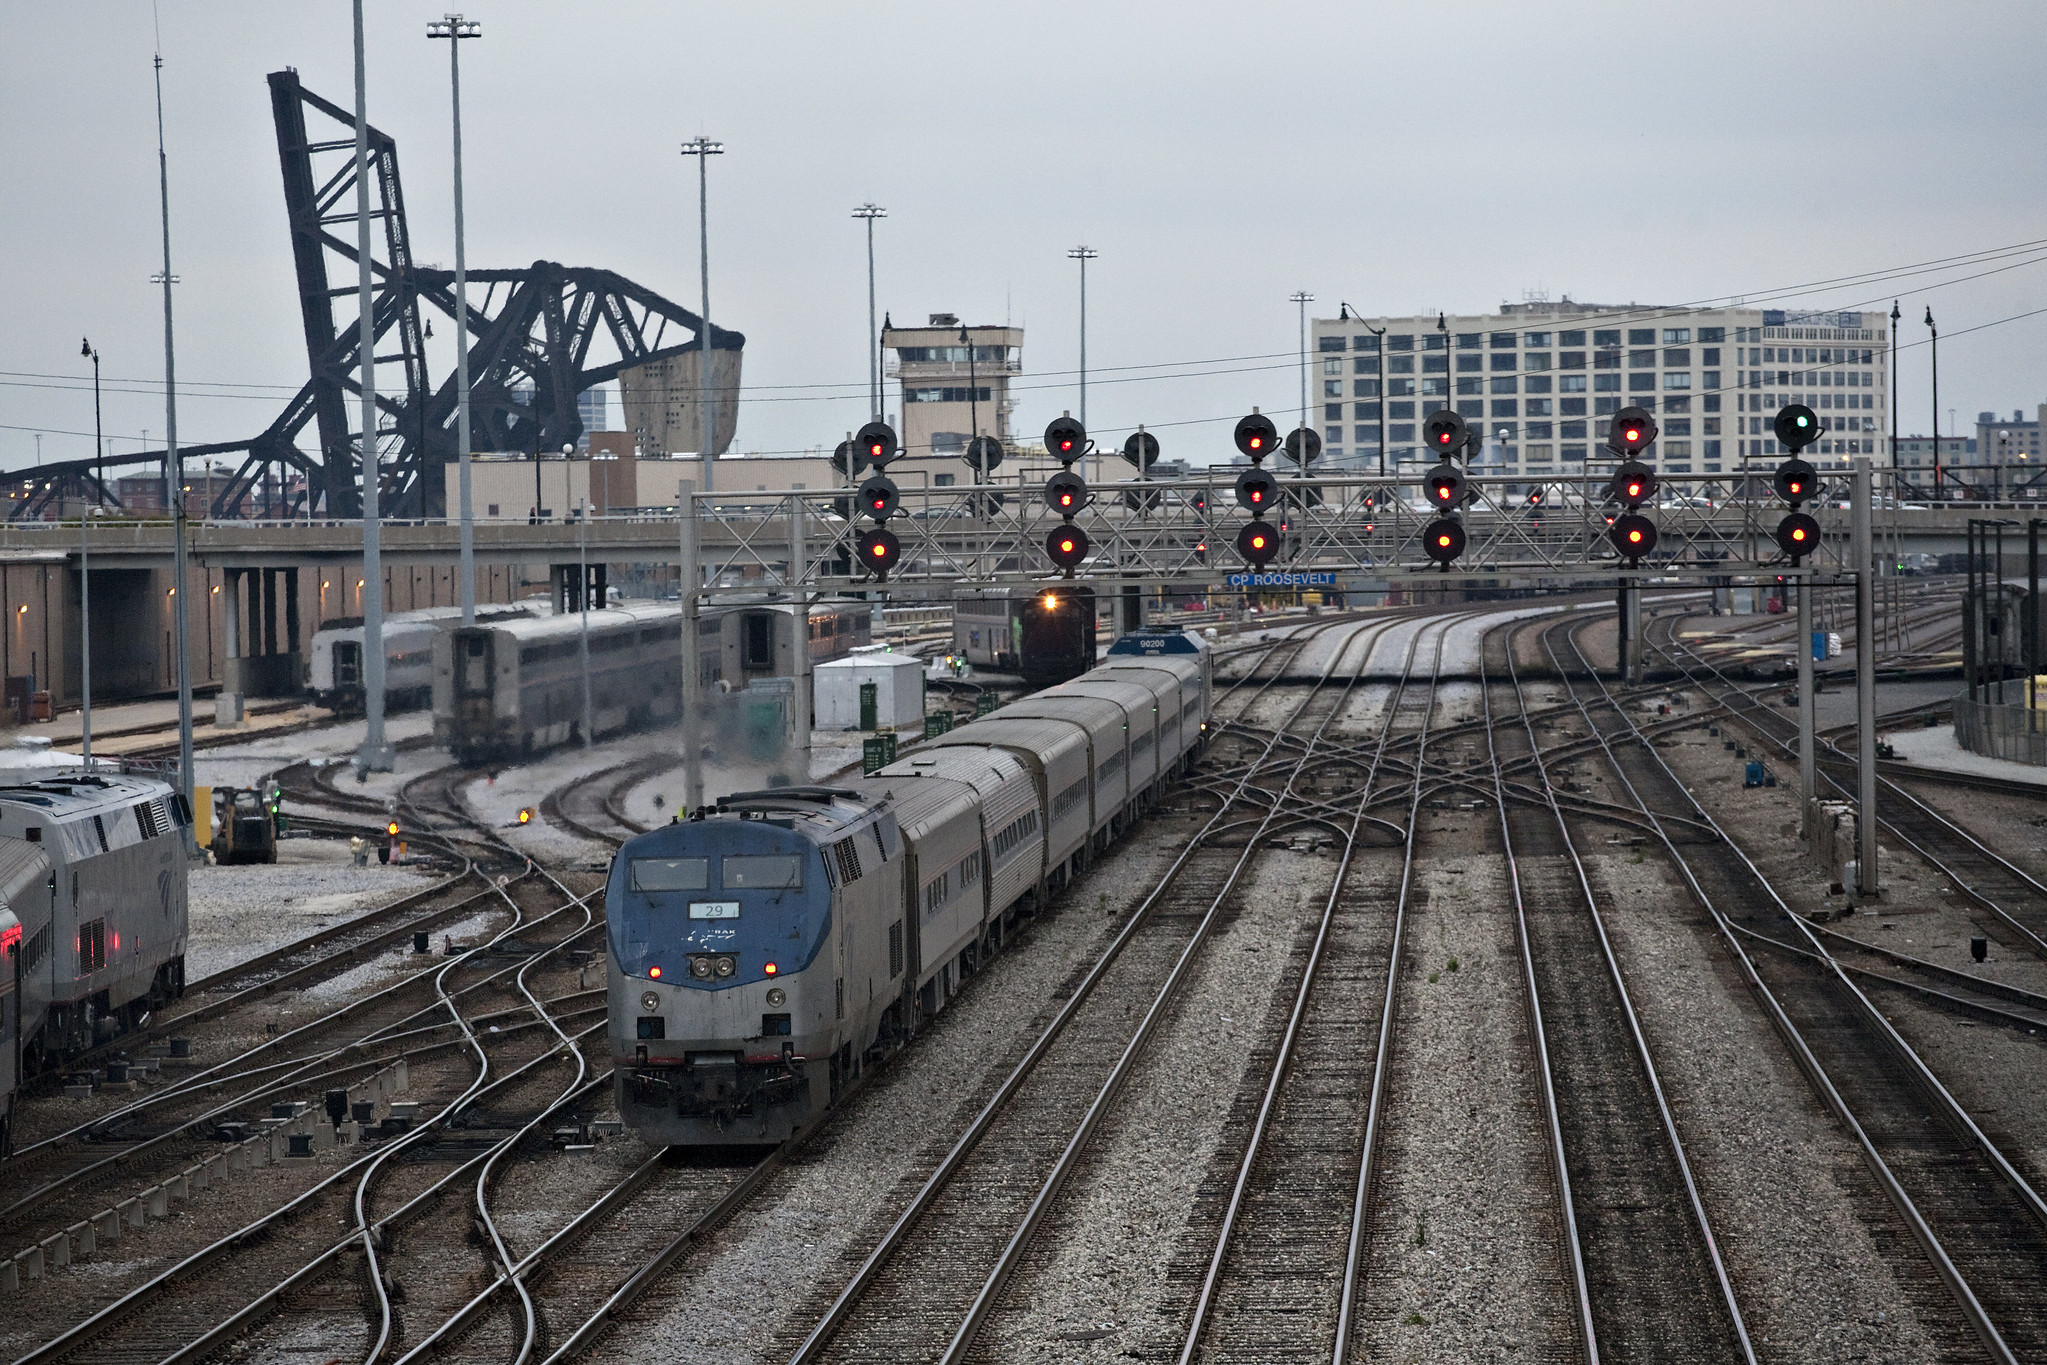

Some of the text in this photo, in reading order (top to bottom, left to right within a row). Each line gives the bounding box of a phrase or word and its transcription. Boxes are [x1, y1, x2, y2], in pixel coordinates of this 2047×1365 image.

[1231, 573, 1332, 586] CP ROOSEVELT
[1139, 639, 1165, 648] 90200
[705, 905, 723, 917] 29
